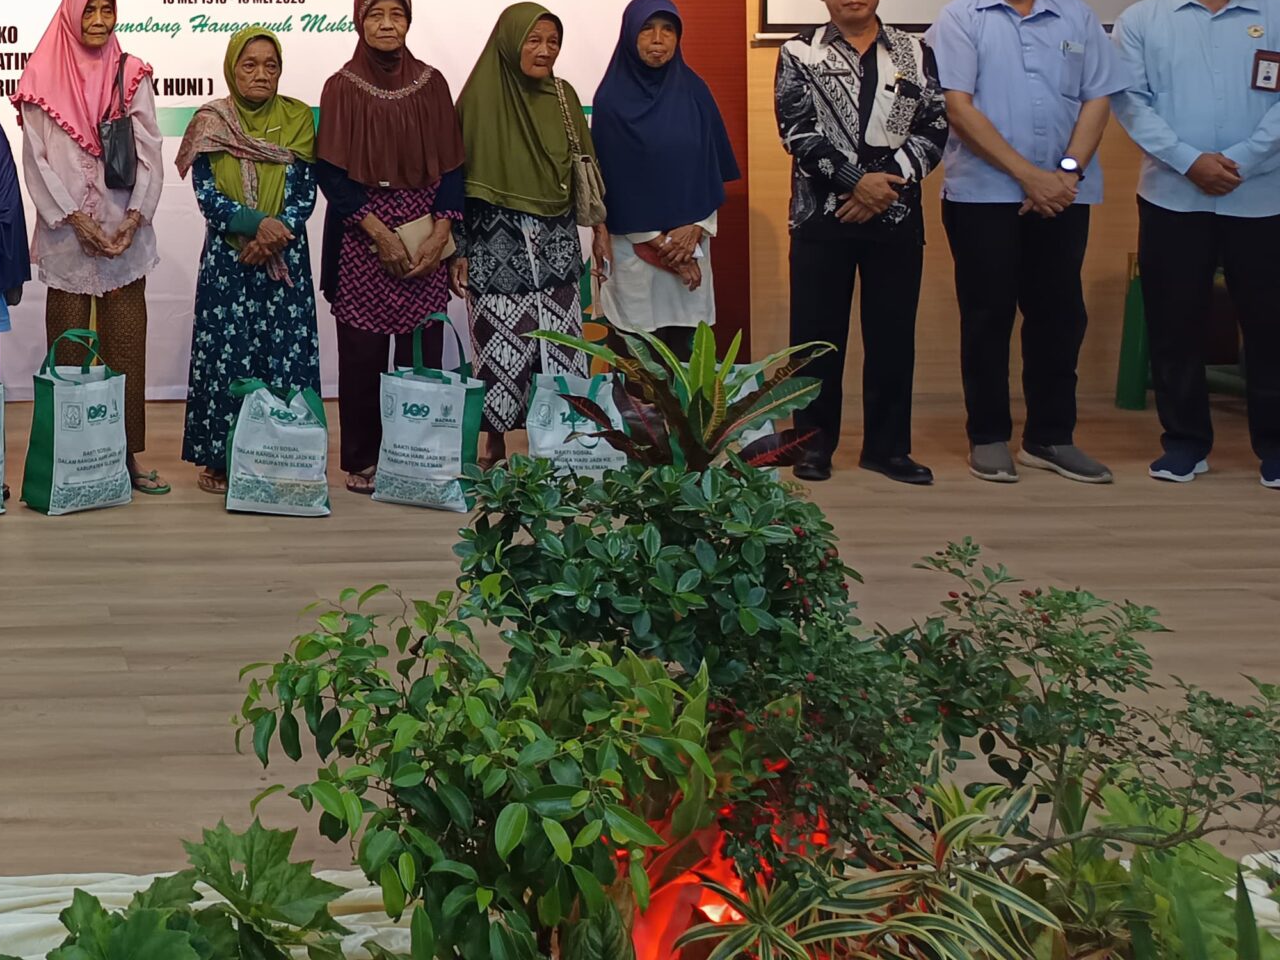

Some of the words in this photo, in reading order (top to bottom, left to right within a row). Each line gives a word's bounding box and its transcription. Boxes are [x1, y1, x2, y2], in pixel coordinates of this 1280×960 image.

[113, 16, 181, 38] umolong
[300, 13, 357, 33] Mukt
[163, 78, 203, 96] HUNI
[402, 402, 430, 417] 109
